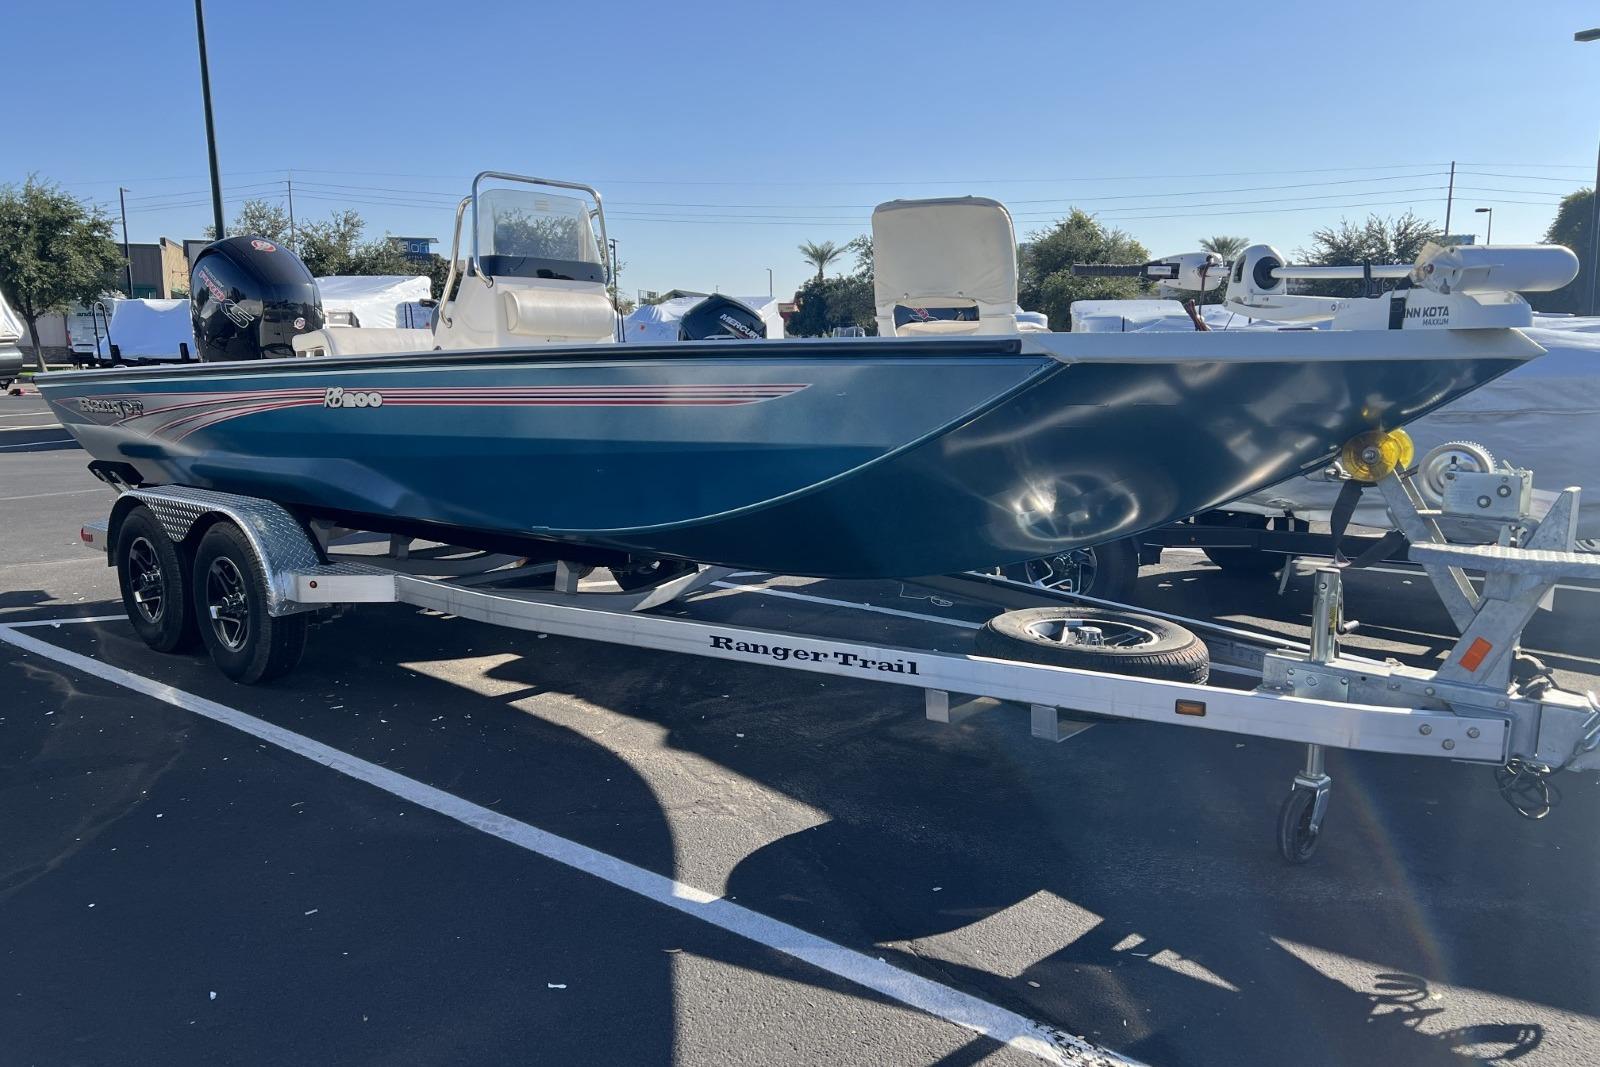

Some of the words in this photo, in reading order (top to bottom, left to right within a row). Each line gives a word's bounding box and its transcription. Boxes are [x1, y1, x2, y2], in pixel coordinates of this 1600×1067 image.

[1422, 306, 1449, 317] KOTA
[1422, 318, 1449, 326] MAXXUM
[719, 313, 763, 340] MERCURY
[79, 396, 144, 420] Ranger
[709, 635, 829, 661] Ranger
[833, 651, 920, 676] Trail
